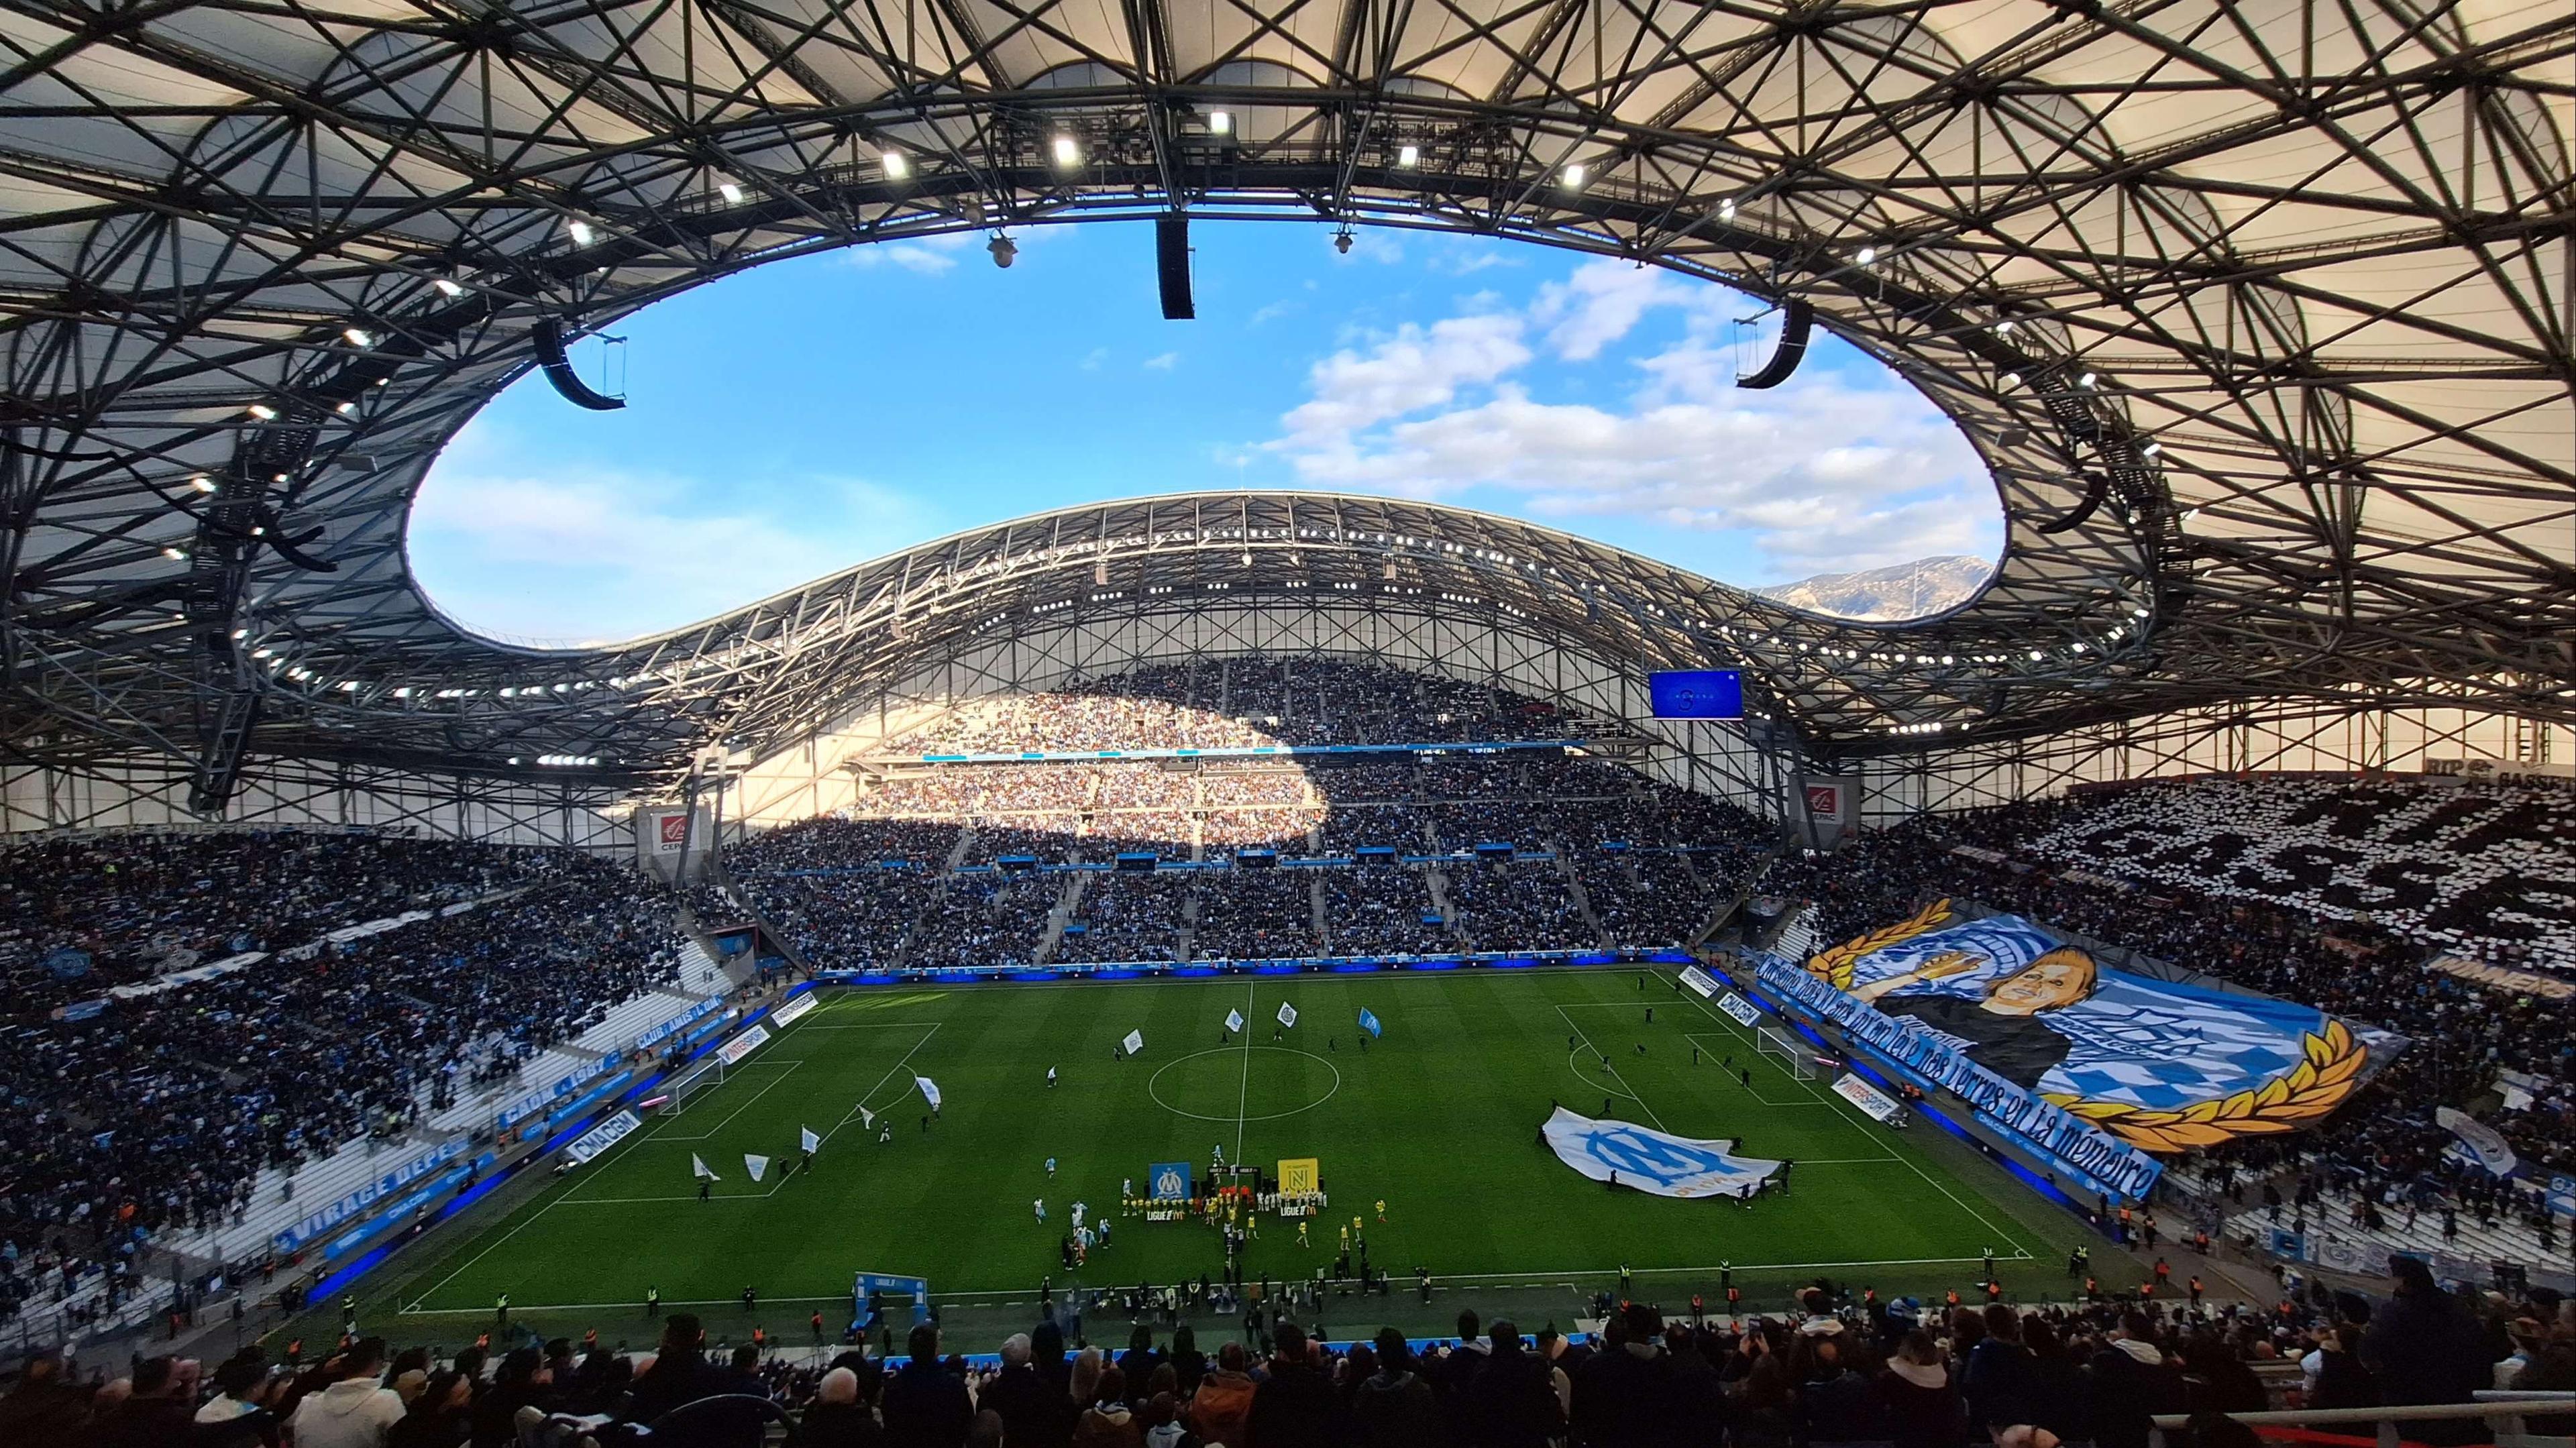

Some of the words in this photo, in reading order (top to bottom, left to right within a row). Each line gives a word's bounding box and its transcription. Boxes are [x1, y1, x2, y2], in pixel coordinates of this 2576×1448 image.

[661, 842, 691, 850] CEP
[637, 1027, 663, 1050] CLUB
[669, 1013, 693, 1034] AMIS
[729, 1027, 766, 1059] INTERSPORT
[570, 1057, 605, 1087] 1987
[1830, 999, 1855, 1021] ans
[1886, 1023, 1920, 1062] lève
[1920, 1047, 1950, 1078] nos
[1946, 1062, 2005, 1112] verres
[2003, 1095, 2033, 1129] en
[2028, 1103, 2057, 1142] ta
[2052, 1123, 2155, 1199] mémoire
[1843, 1080, 1891, 1114] INTERSPORT
[292, 1176, 390, 1241] VIRAGE
[1147, 1211, 1166, 1221] LIGUE
[1281, 1207, 1299, 1216] LIGUE
